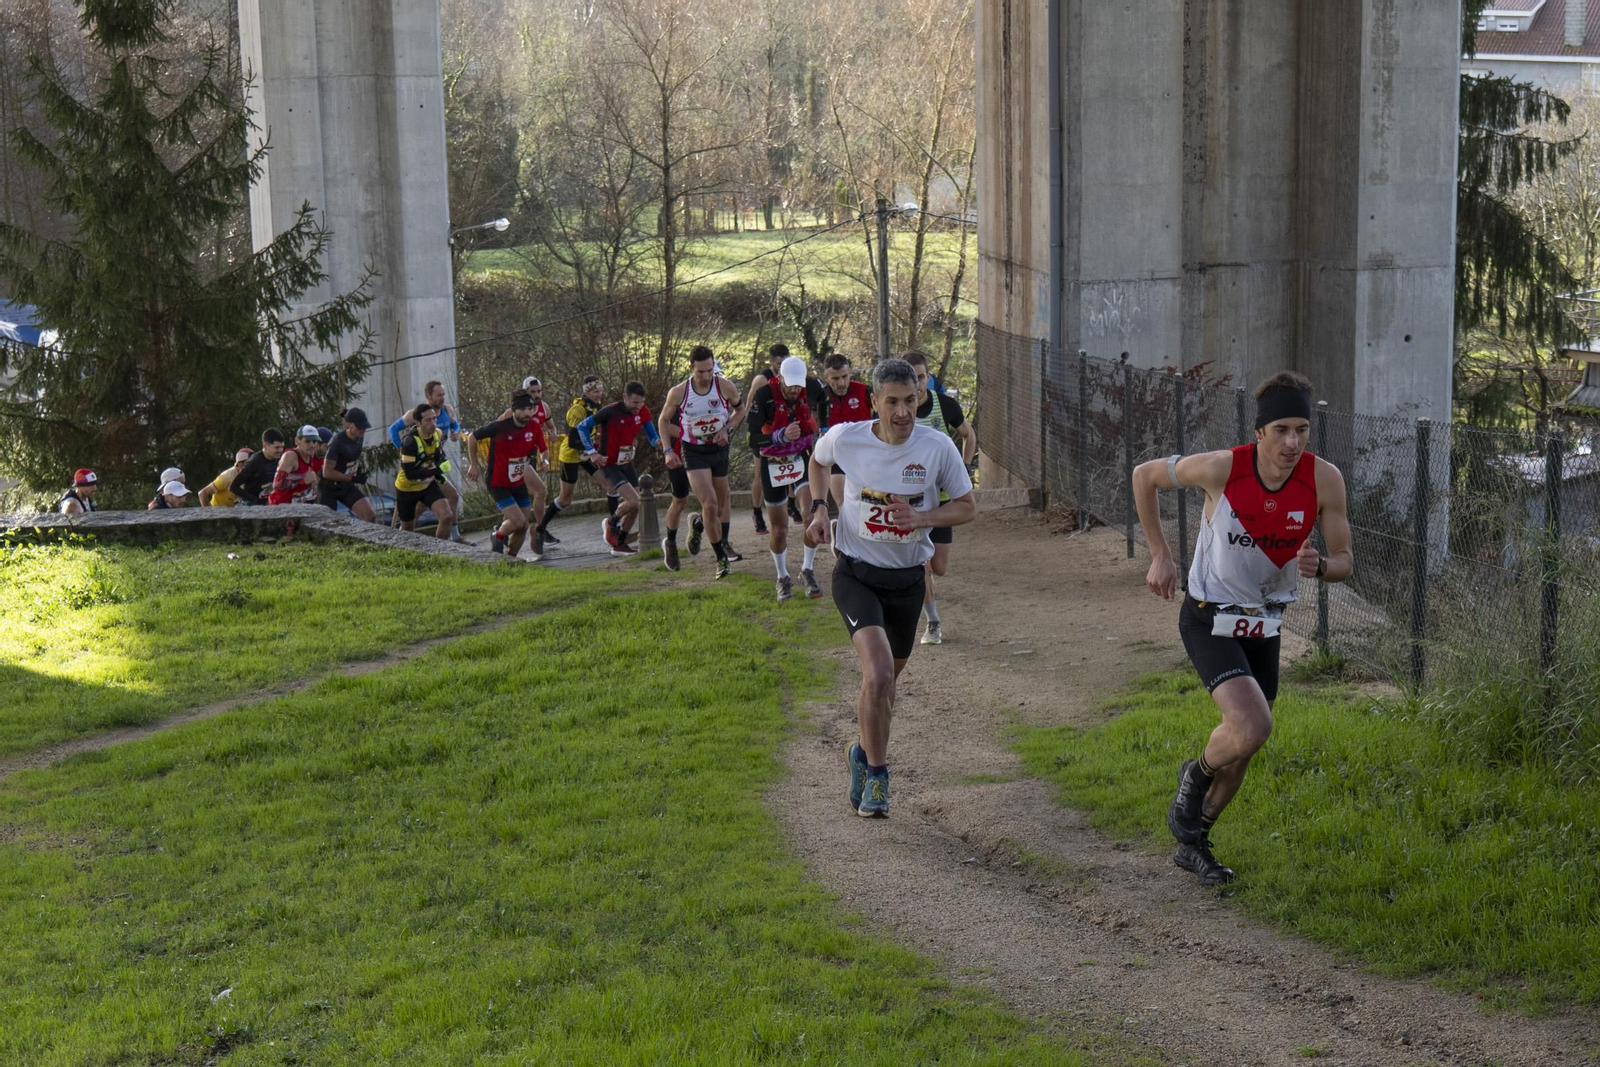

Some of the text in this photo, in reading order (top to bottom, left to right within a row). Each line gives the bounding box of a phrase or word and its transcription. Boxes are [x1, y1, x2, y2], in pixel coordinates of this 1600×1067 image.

[700, 423, 716, 434] 96
[778, 463, 795, 475] 99
[1227, 531, 1299, 550] vértice
[1232, 618, 1265, 639] 84
[1209, 668, 1245, 686] LURBEL
